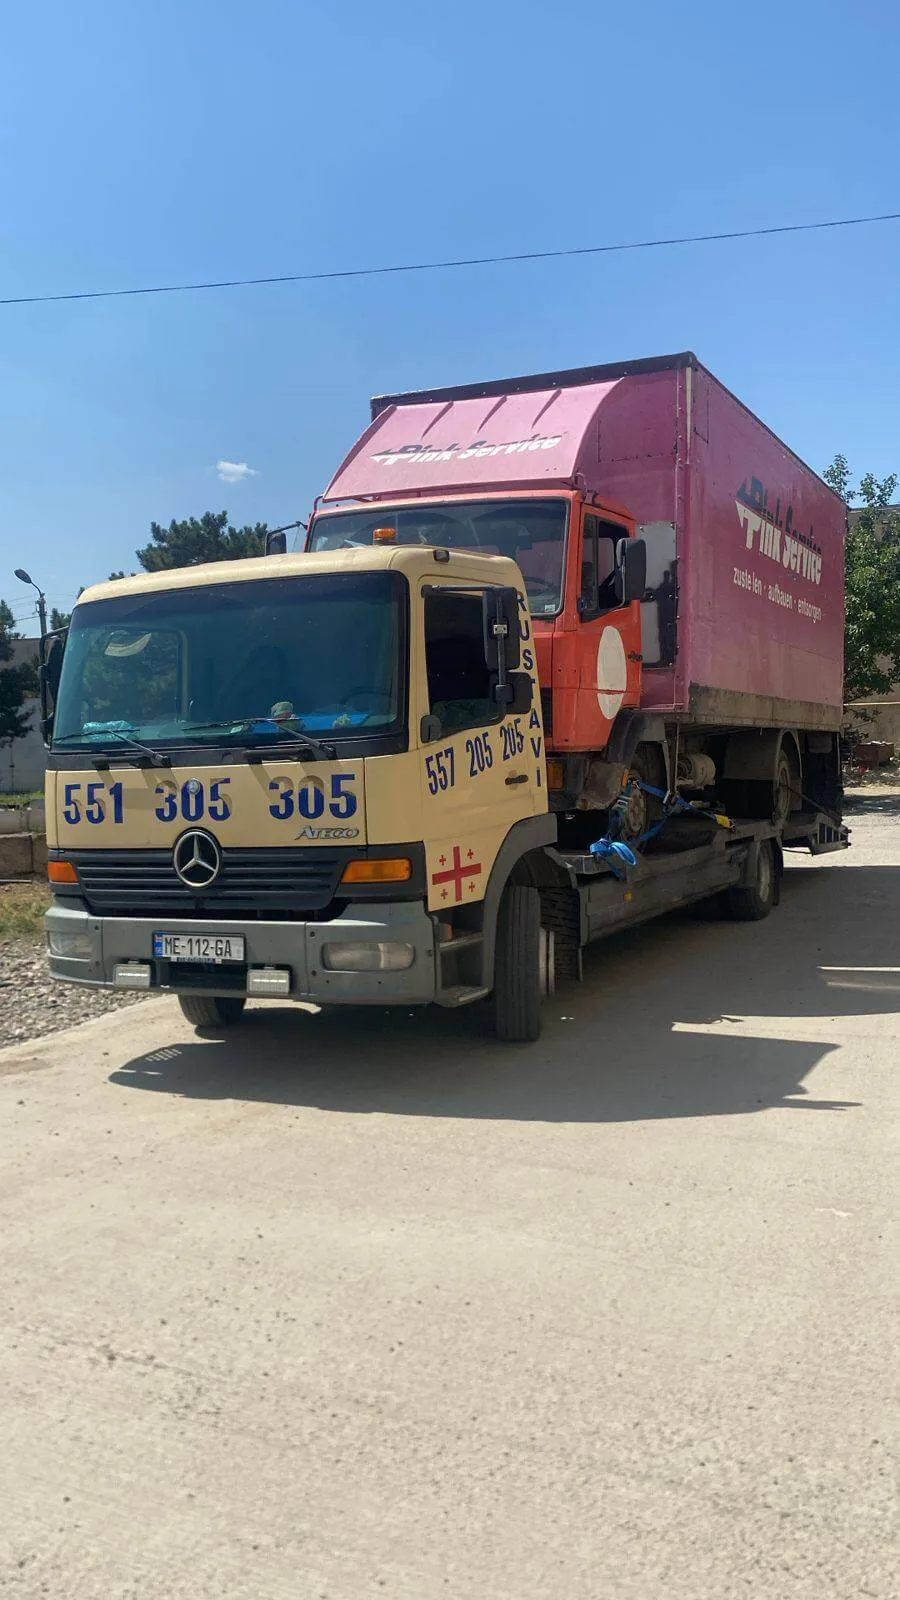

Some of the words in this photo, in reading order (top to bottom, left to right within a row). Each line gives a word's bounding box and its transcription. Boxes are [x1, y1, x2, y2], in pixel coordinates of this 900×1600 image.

[371, 443, 459, 466] Pink
[457, 434, 563, 459] Service
[735, 476, 782, 562] Pink
[782, 505, 822, 585] Service
[733, 567, 762, 596] zustelen
[425, 746, 455, 795] 557
[466, 731, 493, 777] 205
[500, 718, 524, 761] 205
[63, 782, 124, 824] 551
[155, 778, 232, 822] 305
[268, 774, 358, 820] 305
[164, 937, 232, 957] ME-112-GA
